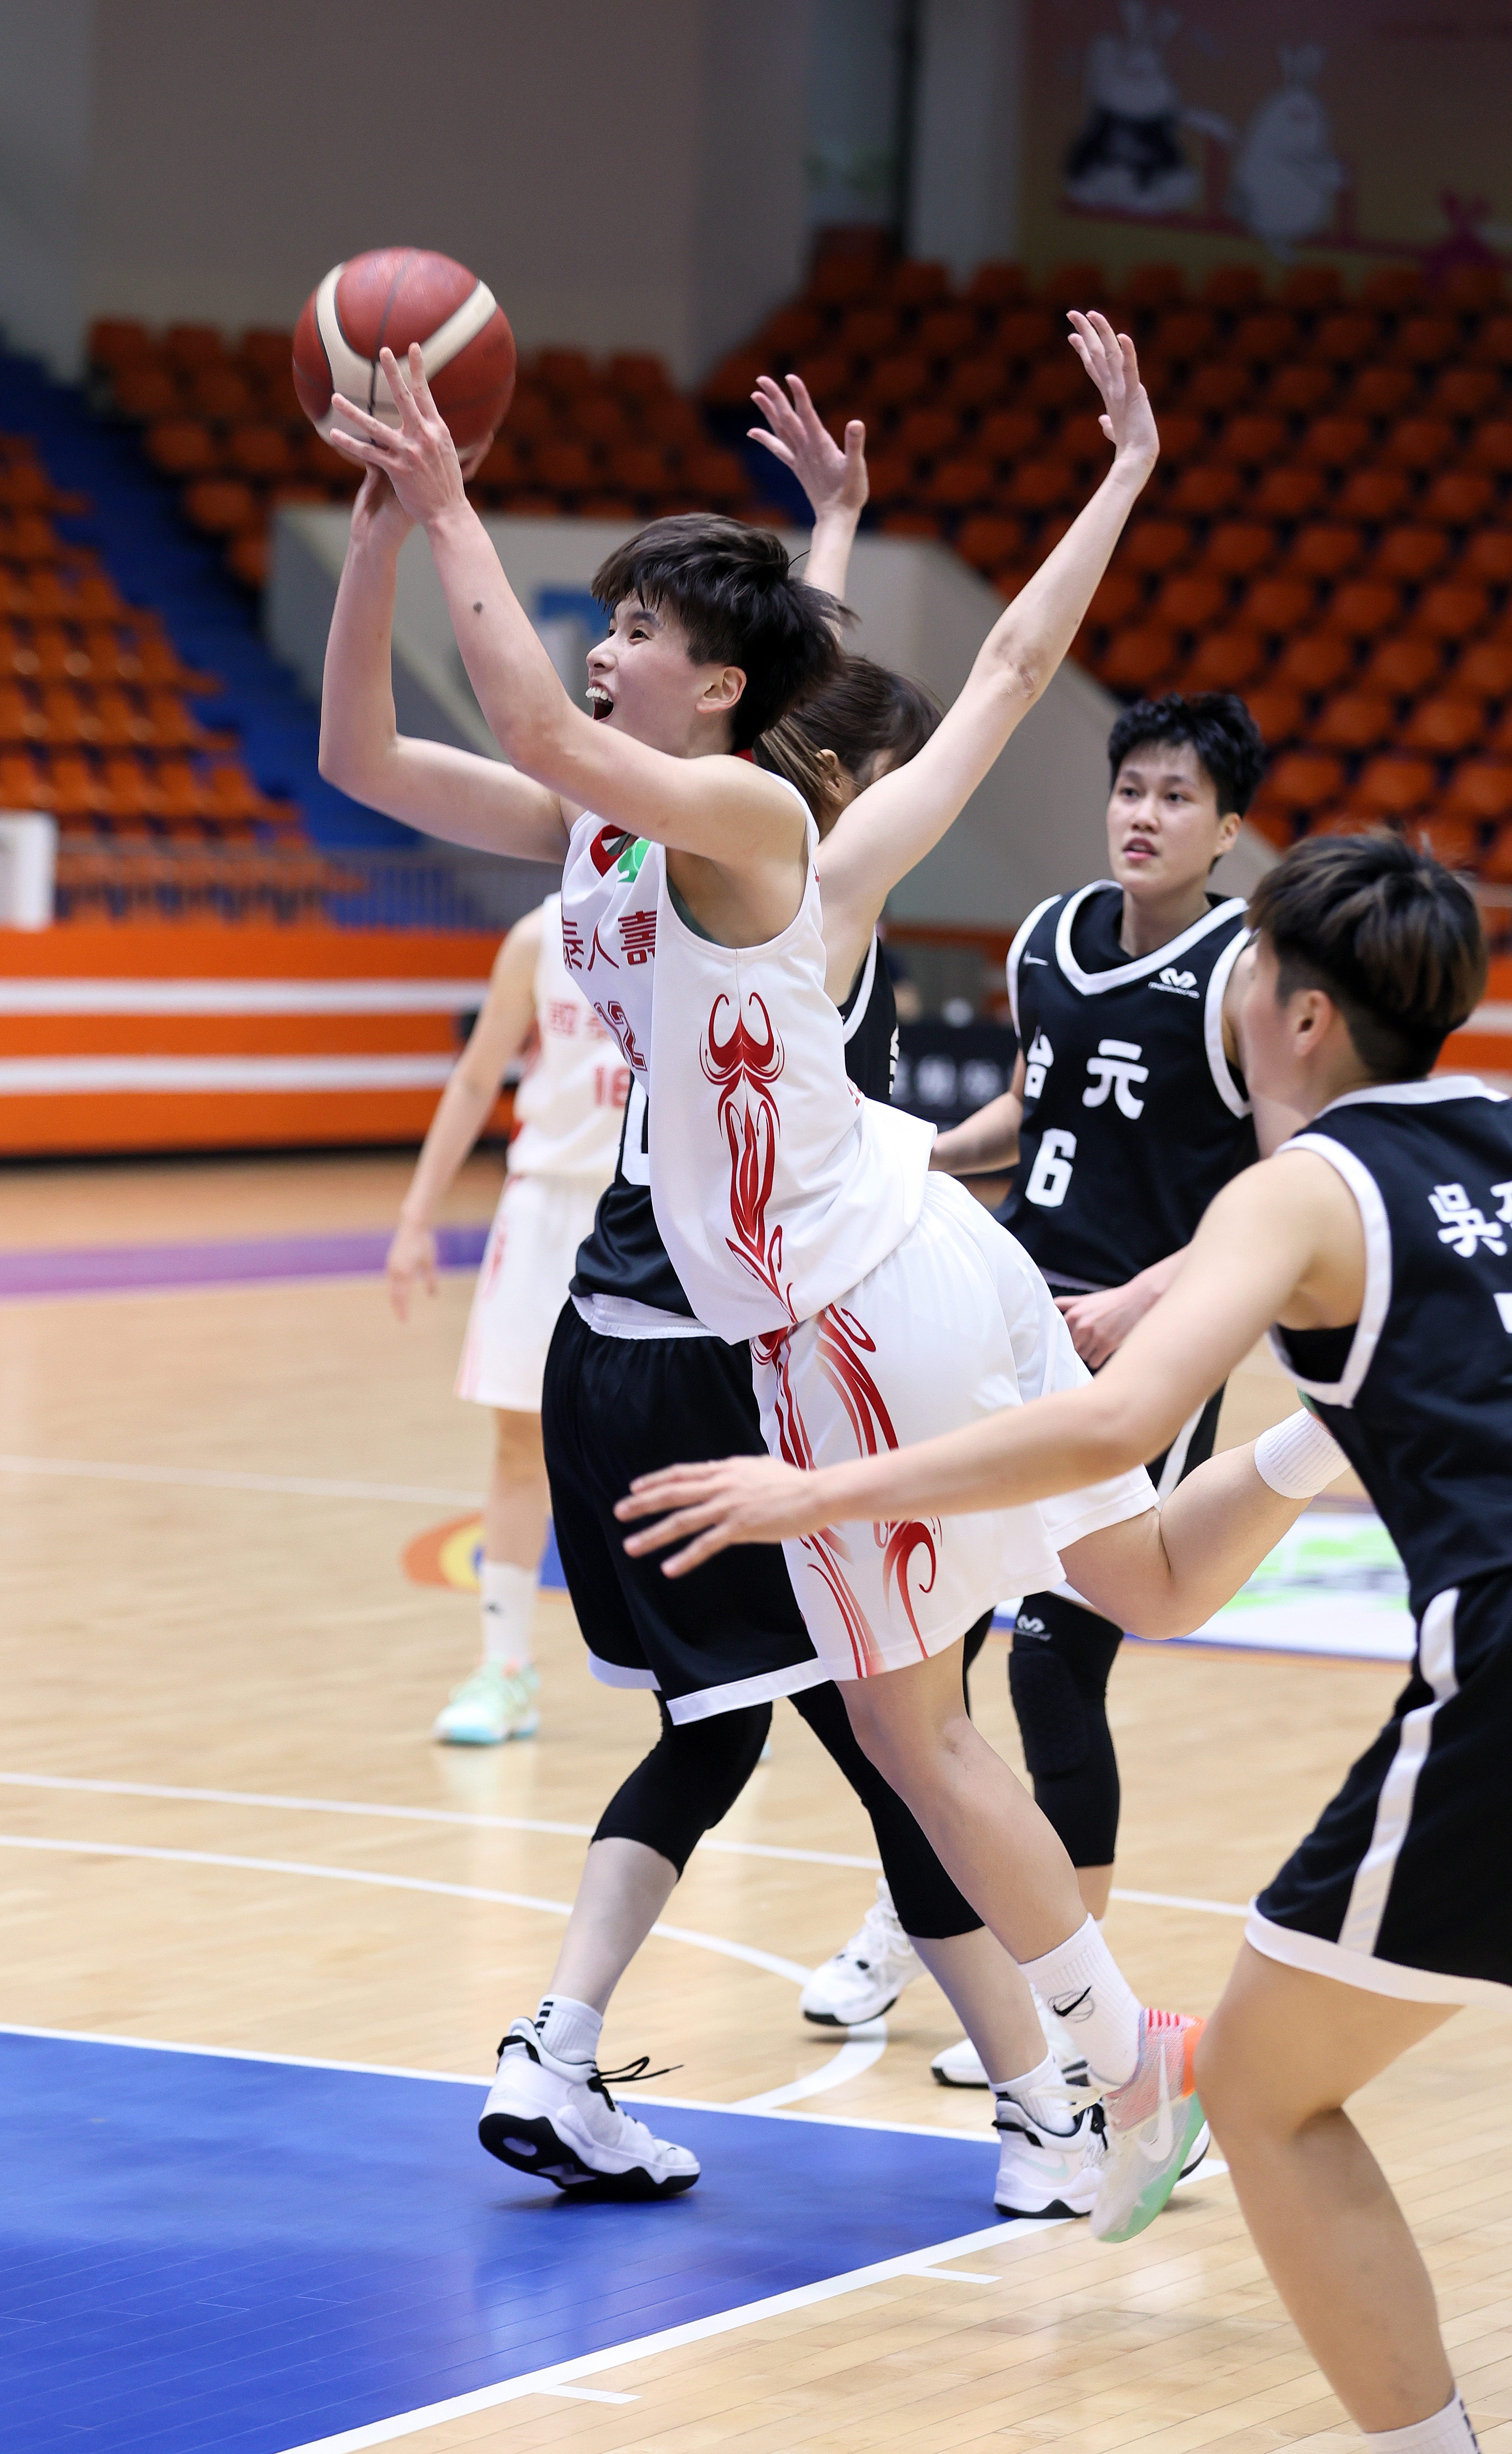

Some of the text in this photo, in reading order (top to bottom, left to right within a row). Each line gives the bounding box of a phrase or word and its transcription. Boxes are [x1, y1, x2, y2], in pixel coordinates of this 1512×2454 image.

[1023, 1026, 1150, 1120] 台元
[1024, 1127, 1078, 1208] 6
[1427, 1182, 1512, 1258] 吳
